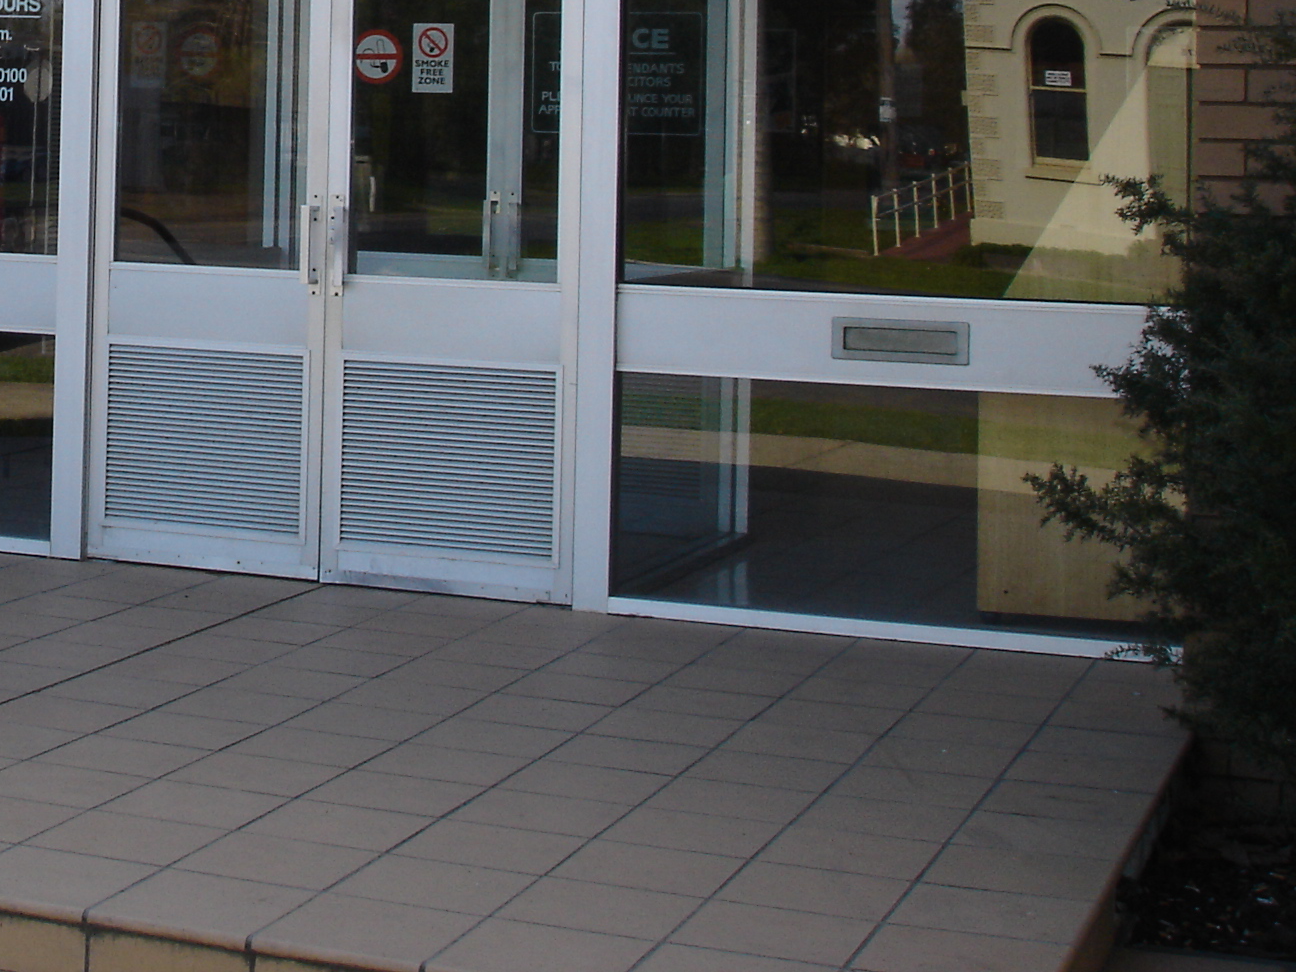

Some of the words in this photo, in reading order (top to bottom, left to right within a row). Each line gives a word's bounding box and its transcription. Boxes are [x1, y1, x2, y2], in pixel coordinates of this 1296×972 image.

[414, 59, 450, 68] SMOKE
[420, 68, 444, 76] FREE
[418, 76, 445, 85] ZONE
[661, 93, 692, 104] YOUR
[641, 106, 695, 118] COUNTER
